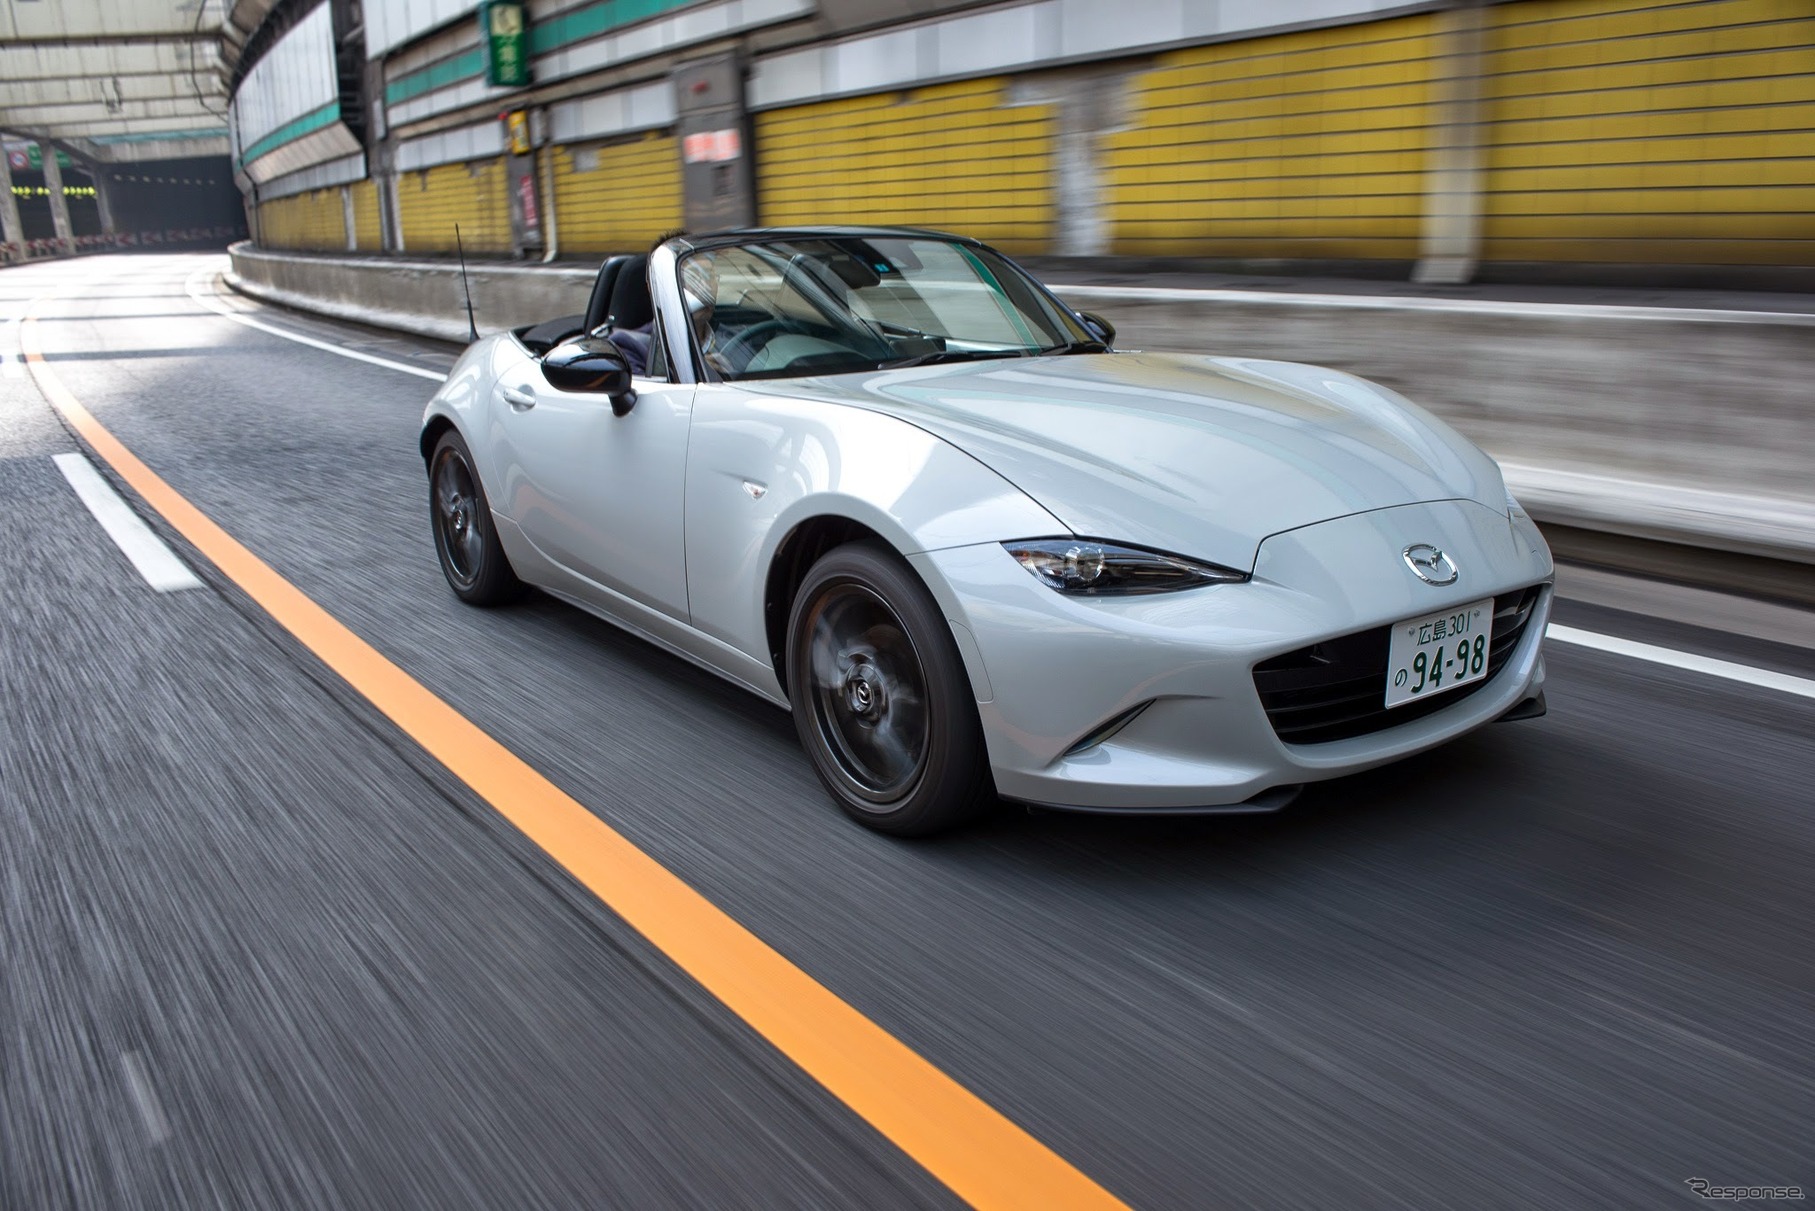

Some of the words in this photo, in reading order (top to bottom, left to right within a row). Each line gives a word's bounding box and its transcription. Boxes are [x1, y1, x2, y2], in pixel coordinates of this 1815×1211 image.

[1417, 619, 1447, 646] 広島
[1448, 611, 1471, 637] 301
[1394, 668, 1408, 688] の
[1410, 633, 1485, 694] 94-98
